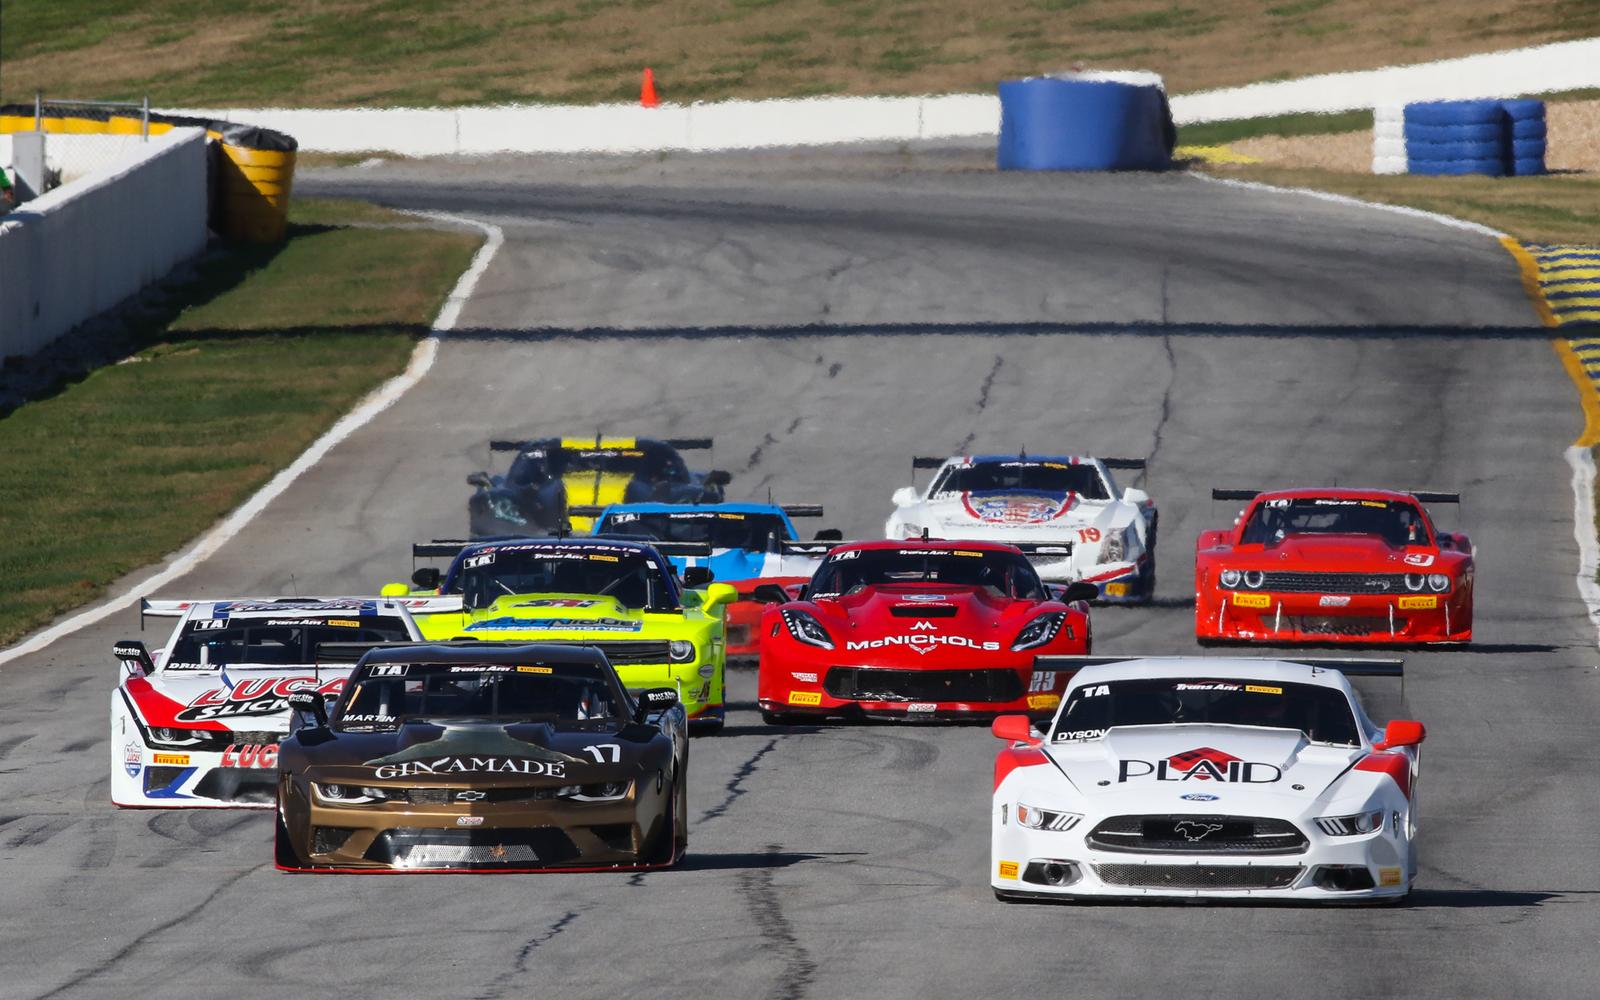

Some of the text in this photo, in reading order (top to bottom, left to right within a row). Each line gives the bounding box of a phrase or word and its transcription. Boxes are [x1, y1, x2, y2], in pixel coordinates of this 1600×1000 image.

[614, 513, 635, 523] TA
[1078, 527, 1101, 544] 19
[501, 544, 641, 553] INDIANAPOLIS
[834, 552, 857, 561] TA
[468, 557, 491, 568] TA
[1237, 597, 1267, 606] PIRELLI
[1402, 599, 1434, 607] PIRELLI
[201, 620, 224, 629] TA
[846, 635, 1000, 650] McNICHOLS
[377, 666, 402, 675] TA
[1028, 671, 1056, 692] 23
[1083, 685, 1110, 698] TA
[792, 694, 817, 702] PIRELLI
[1057, 729, 1106, 740] DYSON
[583, 744, 621, 763] 17
[153, 754, 190, 764] PIRELLI
[1118, 759, 1282, 783] PLAID
[1186, 793, 1214, 801] Ford
